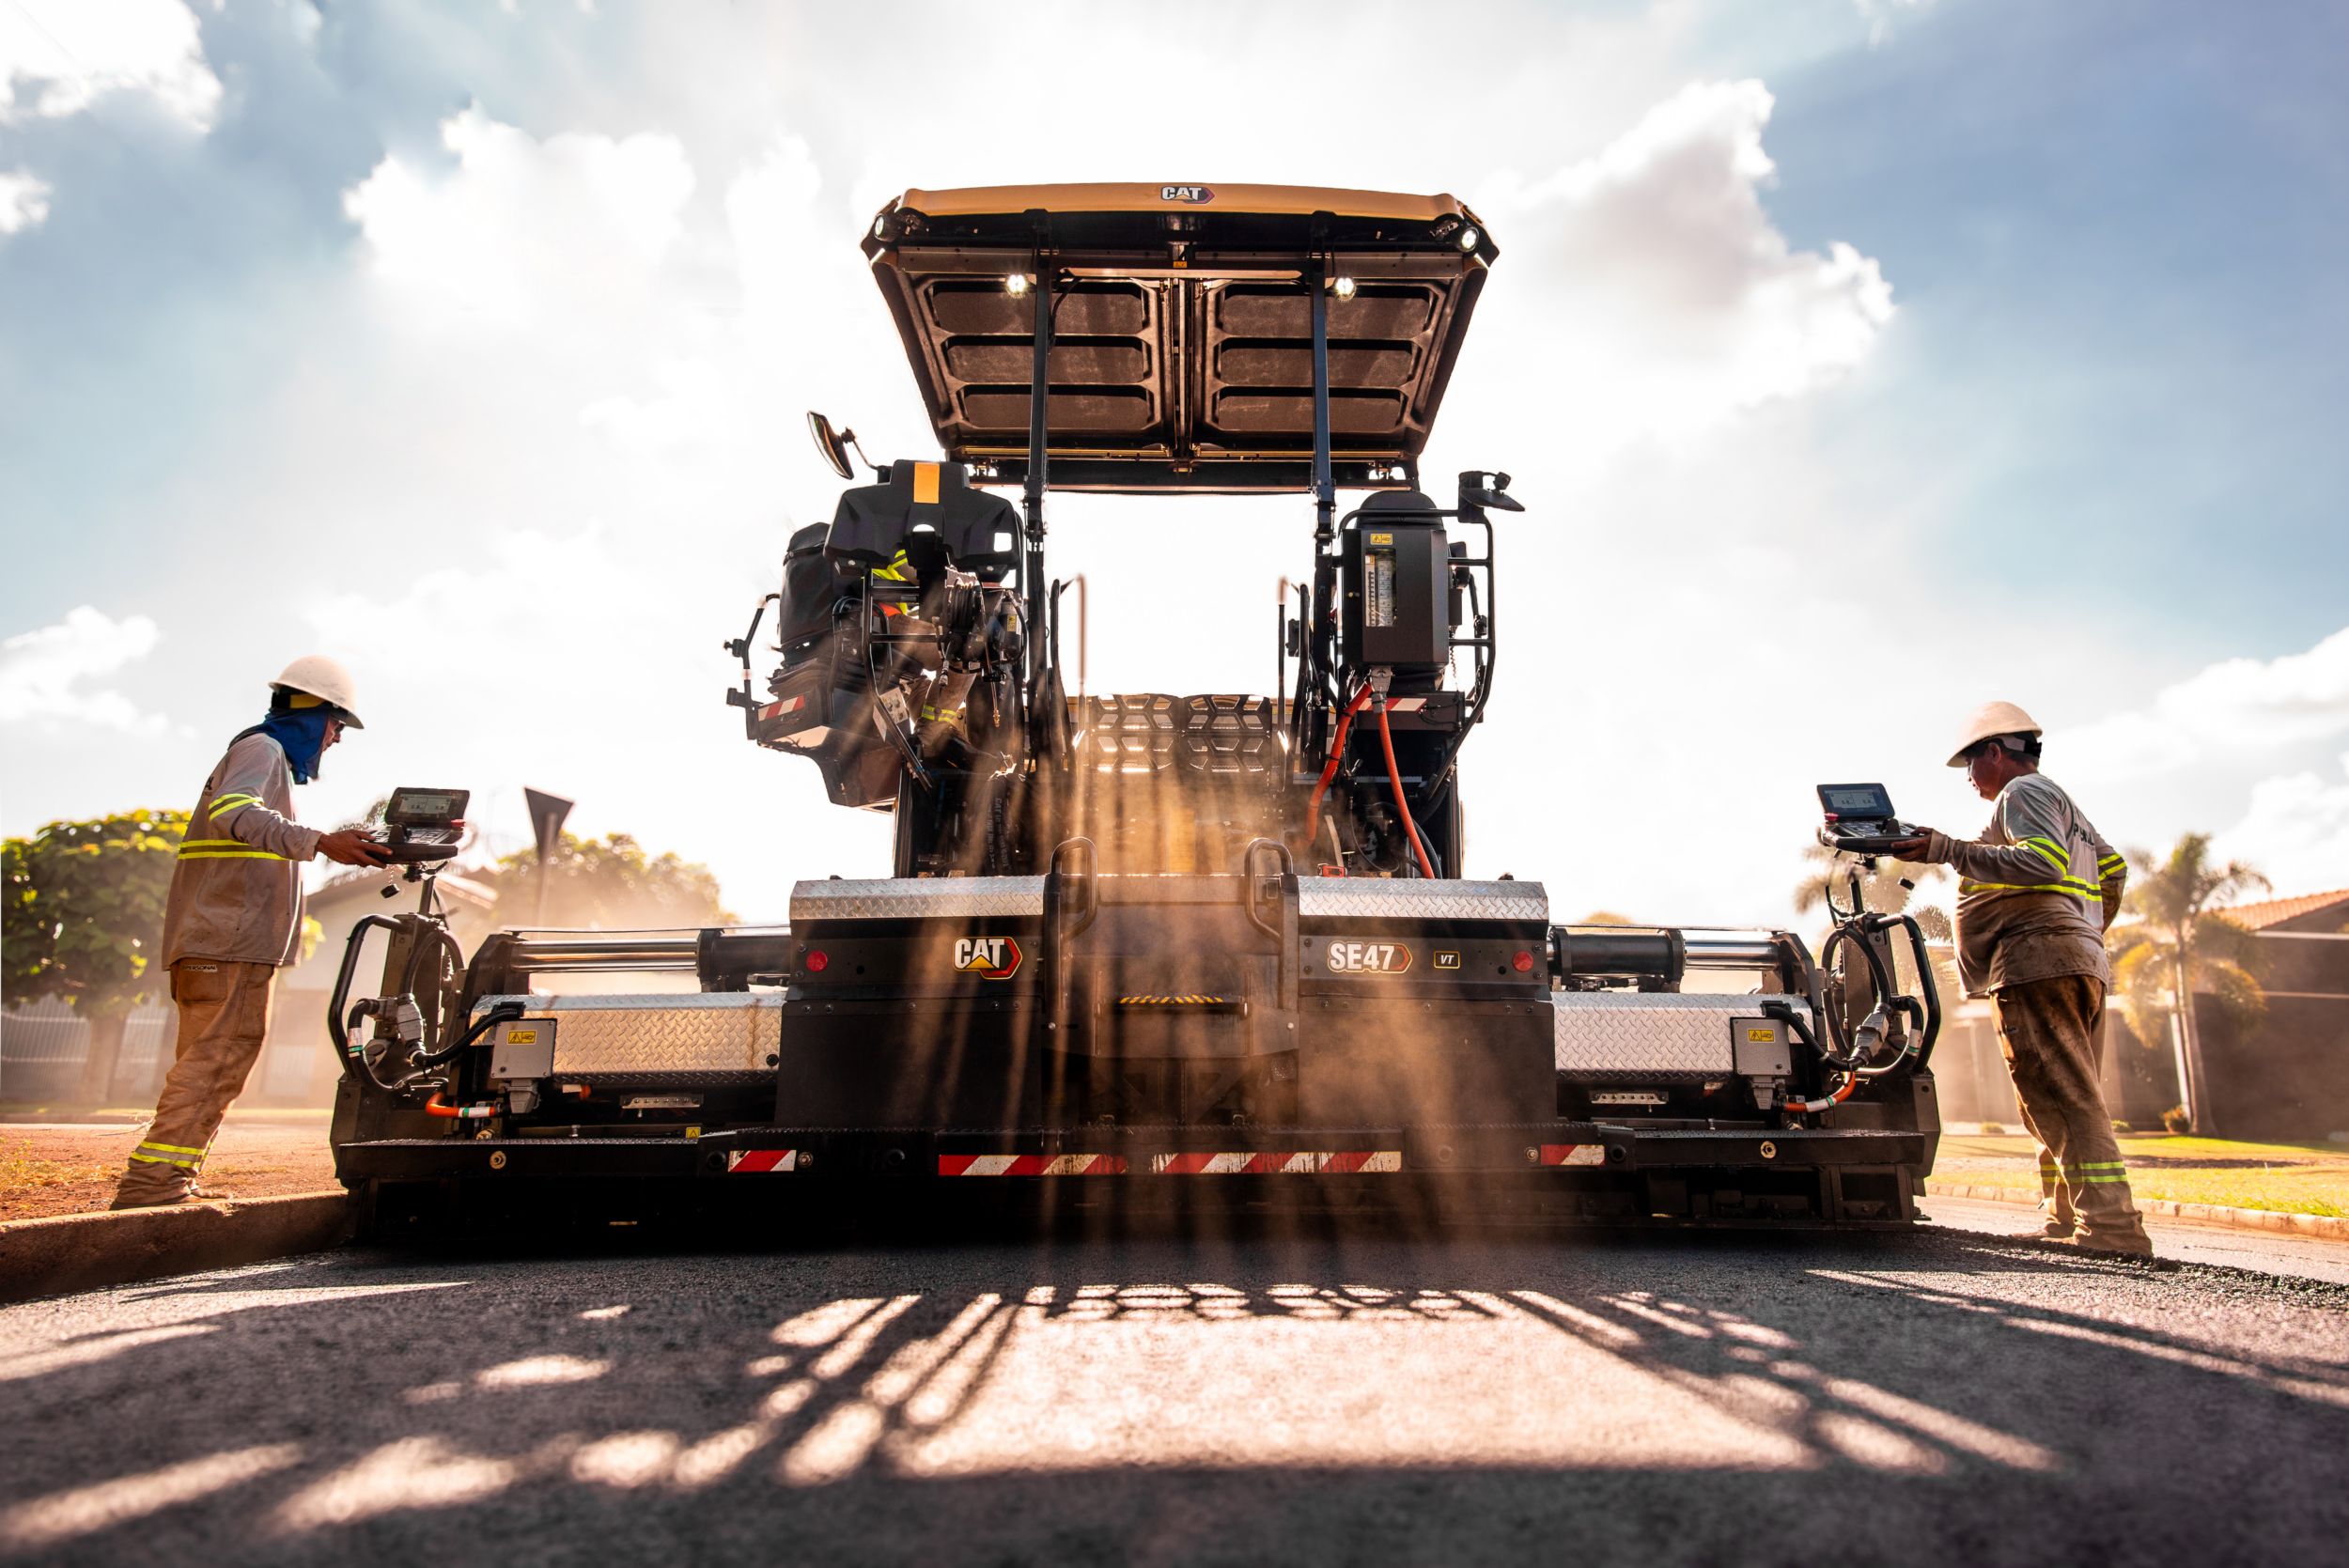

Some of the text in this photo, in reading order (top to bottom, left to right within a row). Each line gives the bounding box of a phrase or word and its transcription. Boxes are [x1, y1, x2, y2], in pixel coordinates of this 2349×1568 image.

[1161, 187, 1202, 200] CAT
[955, 939, 1005, 969] CAT
[1330, 942, 1395, 970] SE47
[1440, 955, 1455, 965] VT
